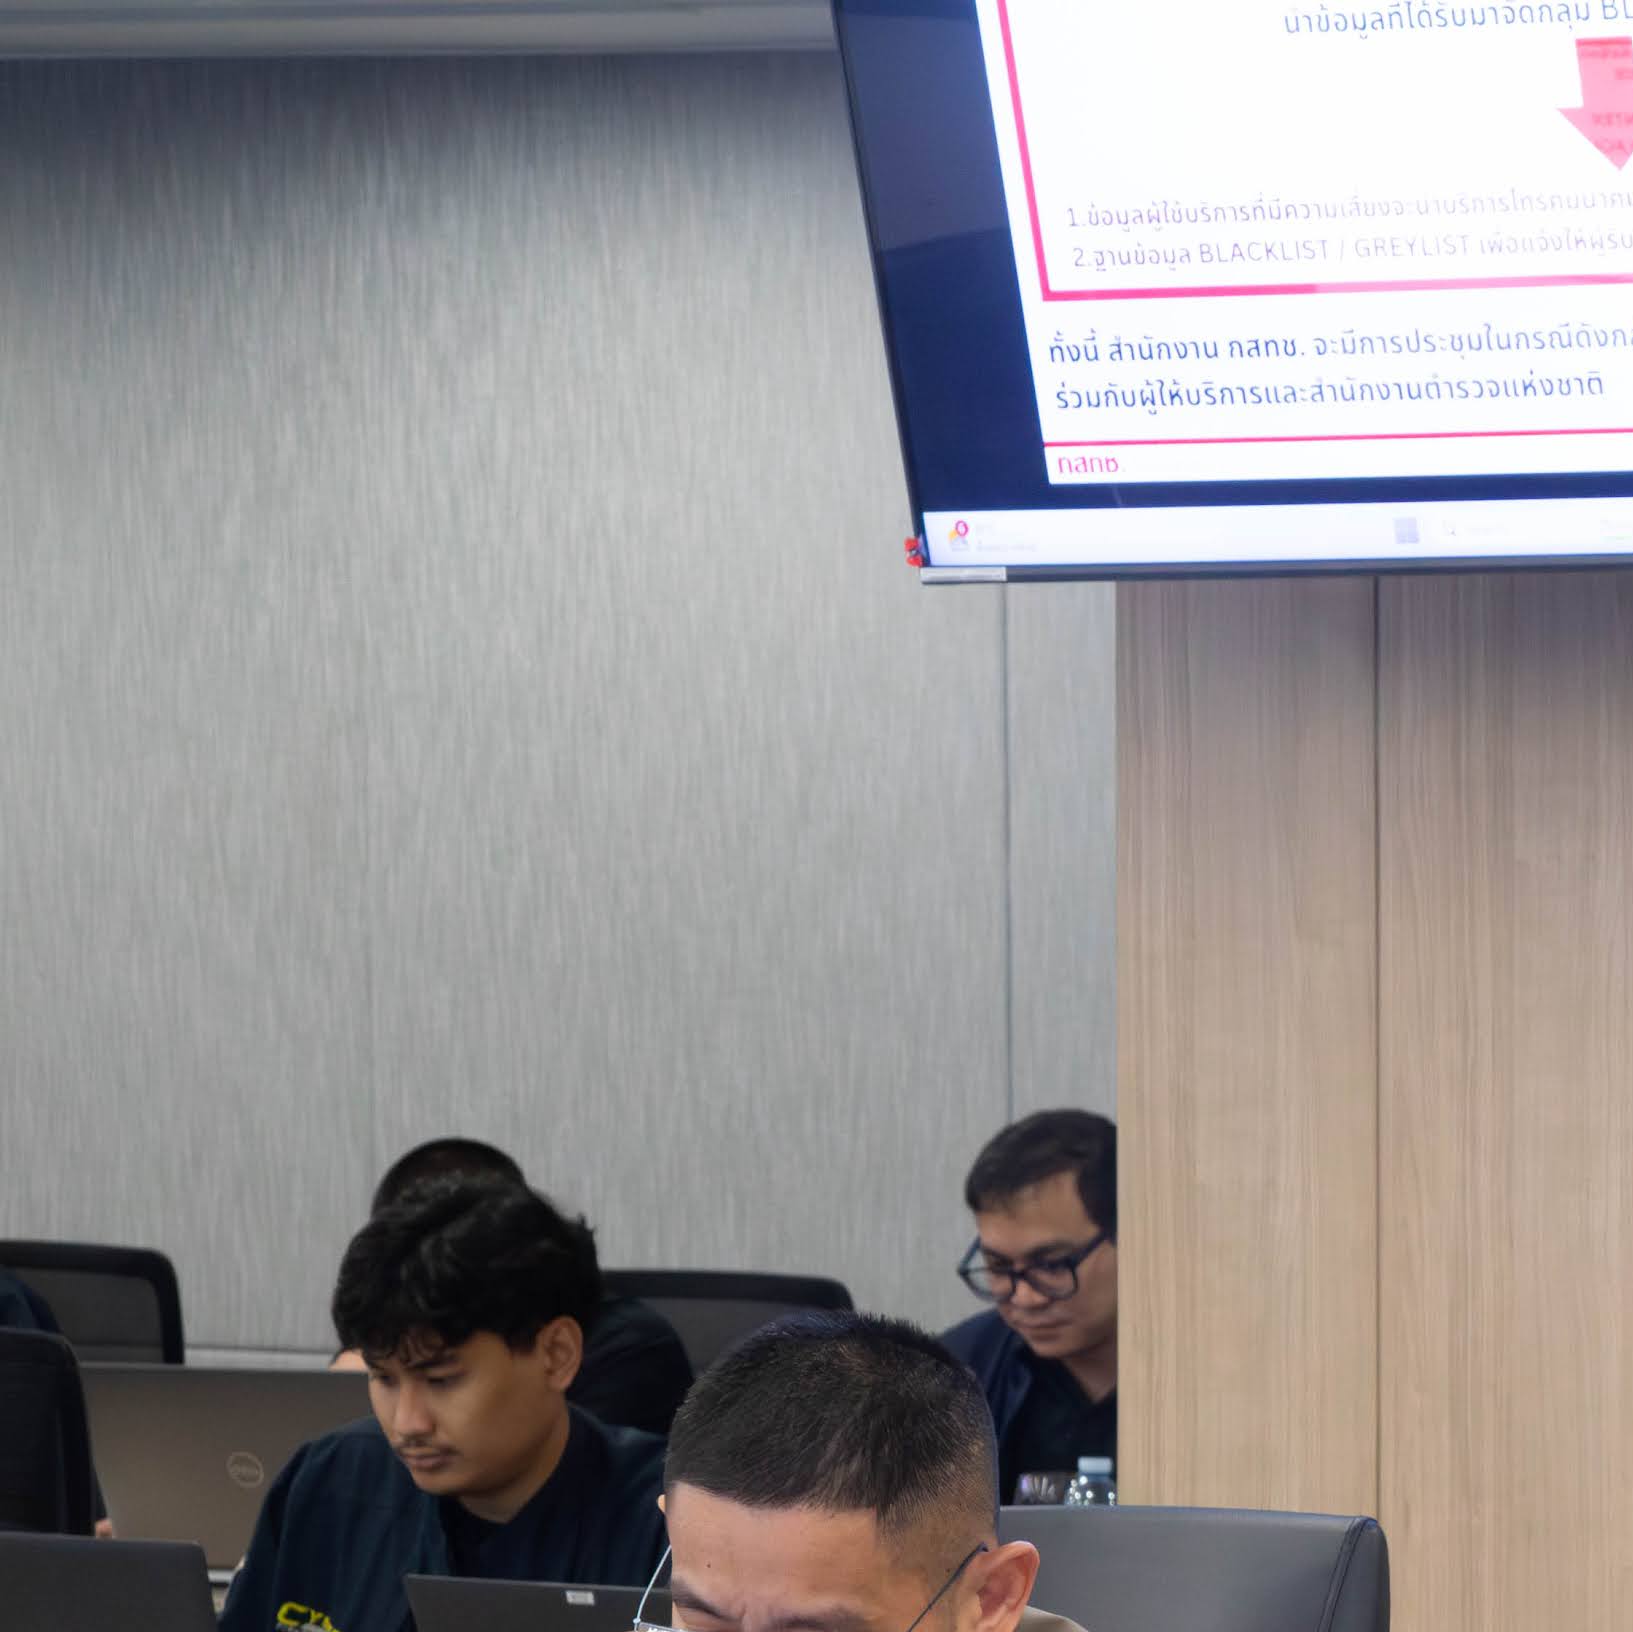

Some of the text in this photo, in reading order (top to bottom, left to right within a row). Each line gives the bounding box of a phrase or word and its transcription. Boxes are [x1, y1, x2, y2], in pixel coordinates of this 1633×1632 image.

[1200, 239, 1330, 265] BLACKLIST
[1354, 235, 1469, 259] GREYLIST
[1108, 334, 1220, 362] สำนักงาน
[1229, 336, 1305, 359] กสทช.
